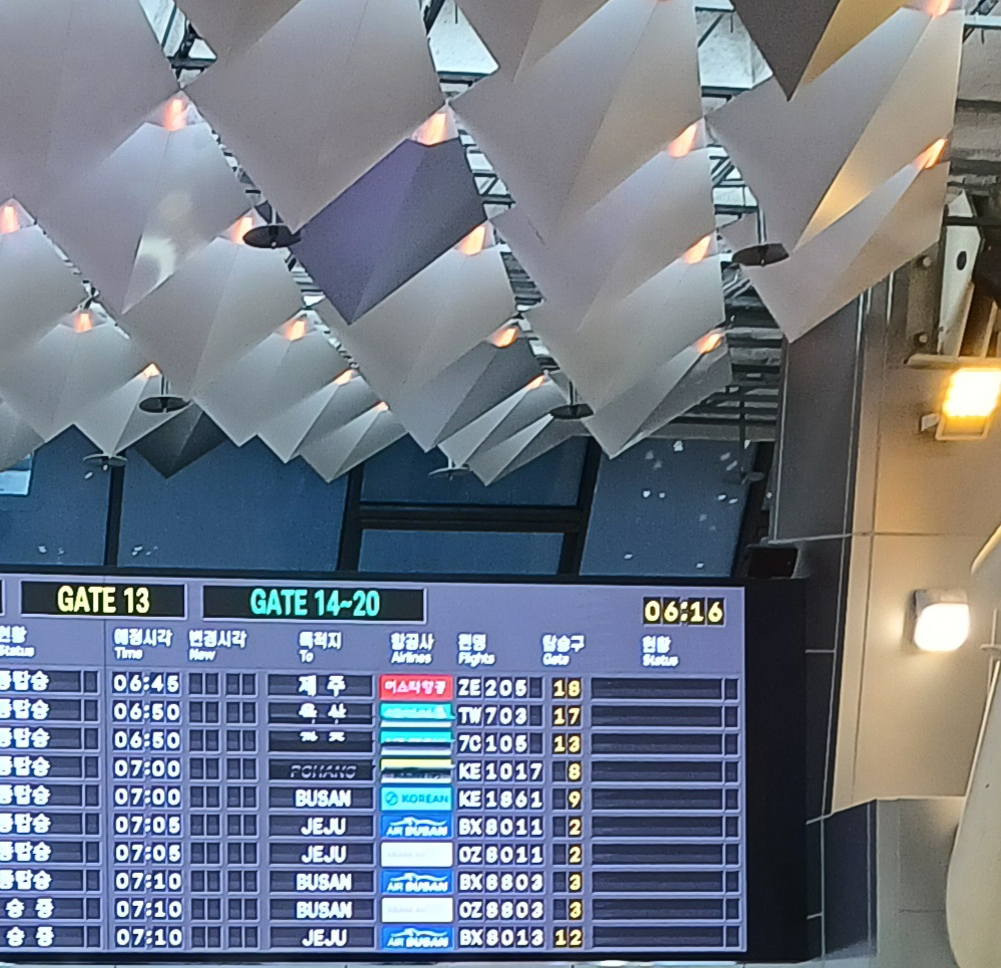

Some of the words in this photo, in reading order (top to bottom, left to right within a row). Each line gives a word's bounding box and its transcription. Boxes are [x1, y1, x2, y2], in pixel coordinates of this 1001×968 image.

[57, 585, 117, 614] GATE
[123, 587, 150, 614] 13
[250, 585, 310, 616] GATE
[314, 589, 380, 617] 14~20
[645, 600, 723, 623] 06:16
[114, 674, 179, 693] 06:45
[458, 678, 527, 697] ZE205
[553, 679, 580, 697] 18
[114, 702, 180, 721] 06:50
[458, 706, 527, 725] TW703
[554, 707, 580, 725] 17
[114, 731, 180, 749] 06:50
[459, 734, 527, 752] 7C105
[554, 735, 580, 753] 13
[115, 759, 180, 777] 07:00
[459, 762, 542, 780] KE1017
[568, 763, 581, 780] 8
[115, 788, 181, 805] 07:00
[295, 789, 351, 807] BUSAN
[401, 793, 449, 804] KOREAN
[459, 790, 542, 808] KE1861
[568, 791, 581, 808] 9
[115, 816, 180, 834] 07:05
[301, 817, 346, 835] JEJU
[459, 818, 543, 835] BX8011
[569, 819, 581, 835] 2
[116, 844, 181, 862] 07:05
[301, 845, 346, 863] JEJU
[569, 846, 581, 863] 2
[116, 872, 181, 890] 07:10
[296, 873, 352, 891] BUSAN
[569, 874, 581, 891] 3
[116, 900, 182, 918] 07:10
[296, 901, 352, 919] BUSAN
[569, 901, 582, 919] 3
[117, 928, 182, 946] 07:10
[302, 928, 347, 947] JEJU
[460, 929, 543, 946] BX8013
[555, 929, 582, 946] 12
